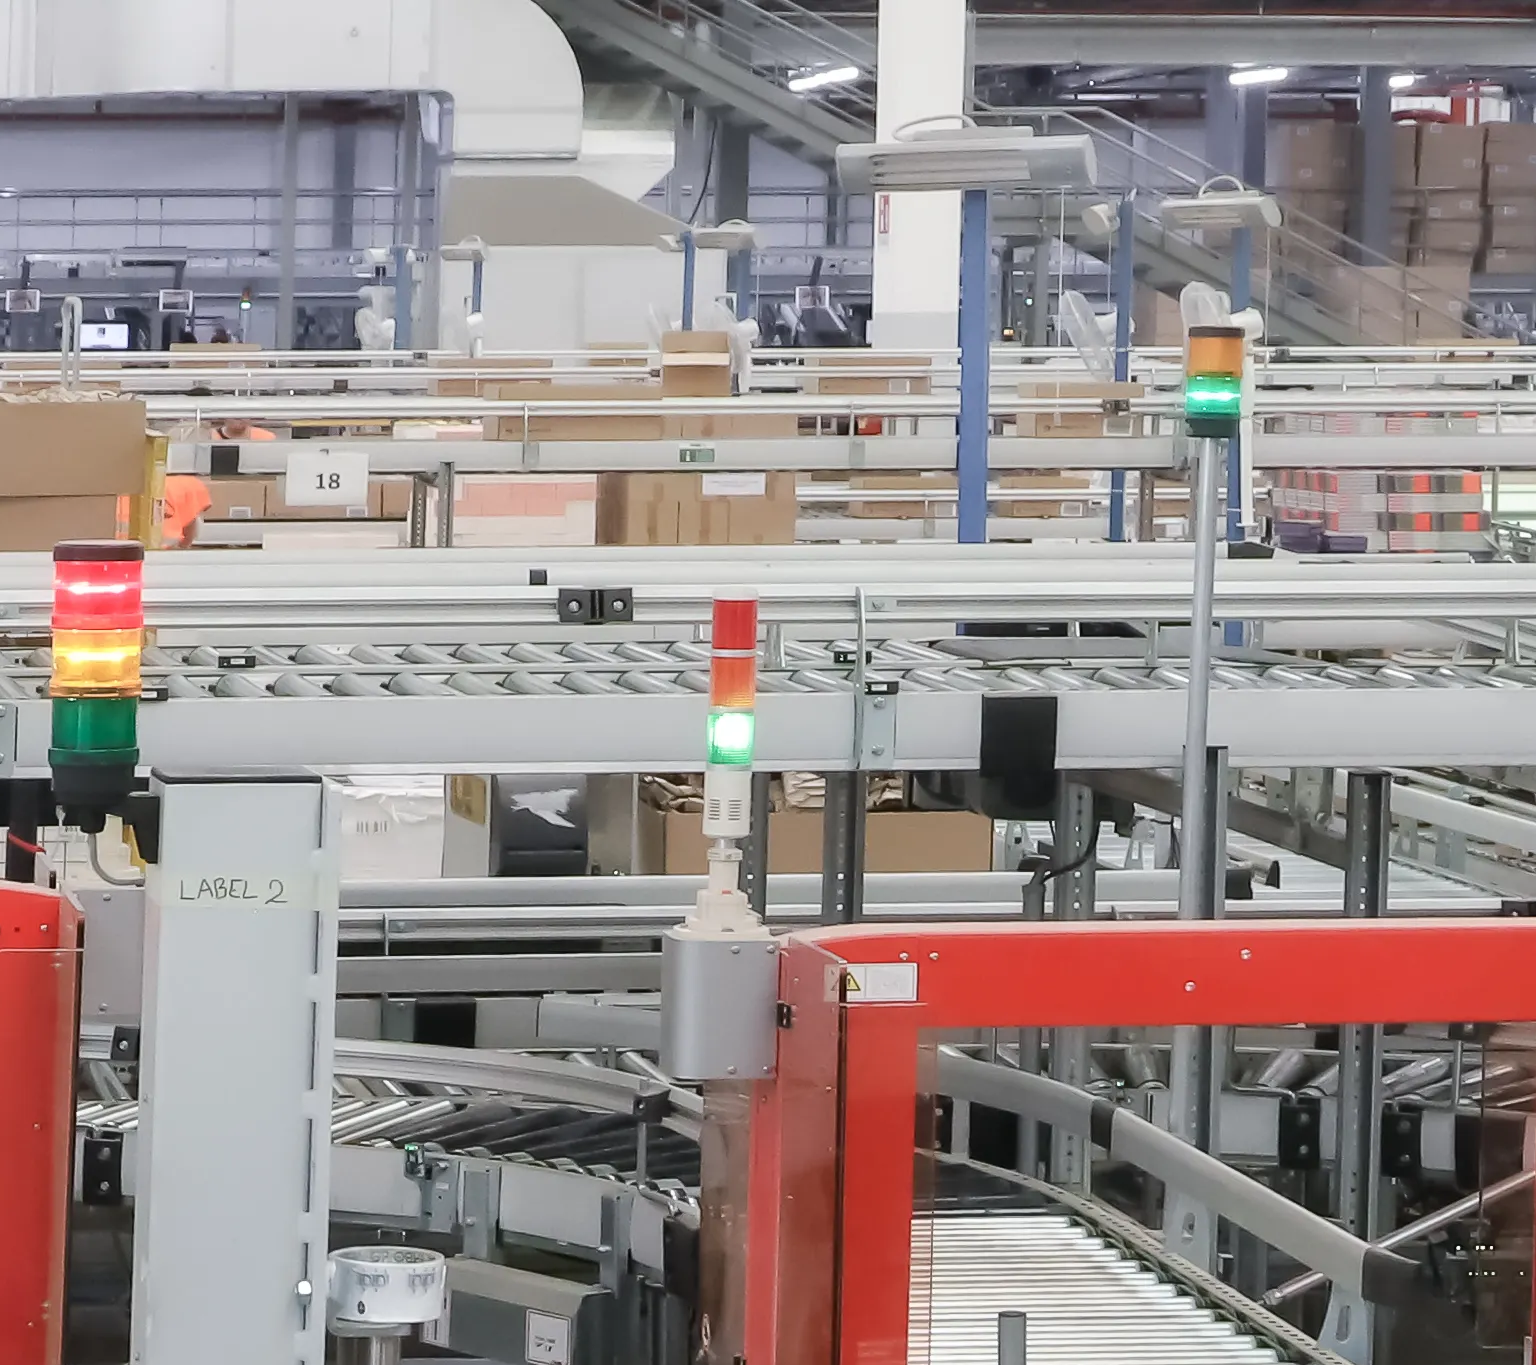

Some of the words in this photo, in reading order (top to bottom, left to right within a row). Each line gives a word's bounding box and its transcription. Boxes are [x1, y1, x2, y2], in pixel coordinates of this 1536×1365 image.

[315, 472, 341, 490] 18
[179, 877, 259, 901] LABEL
[264, 878, 289, 905] 2
